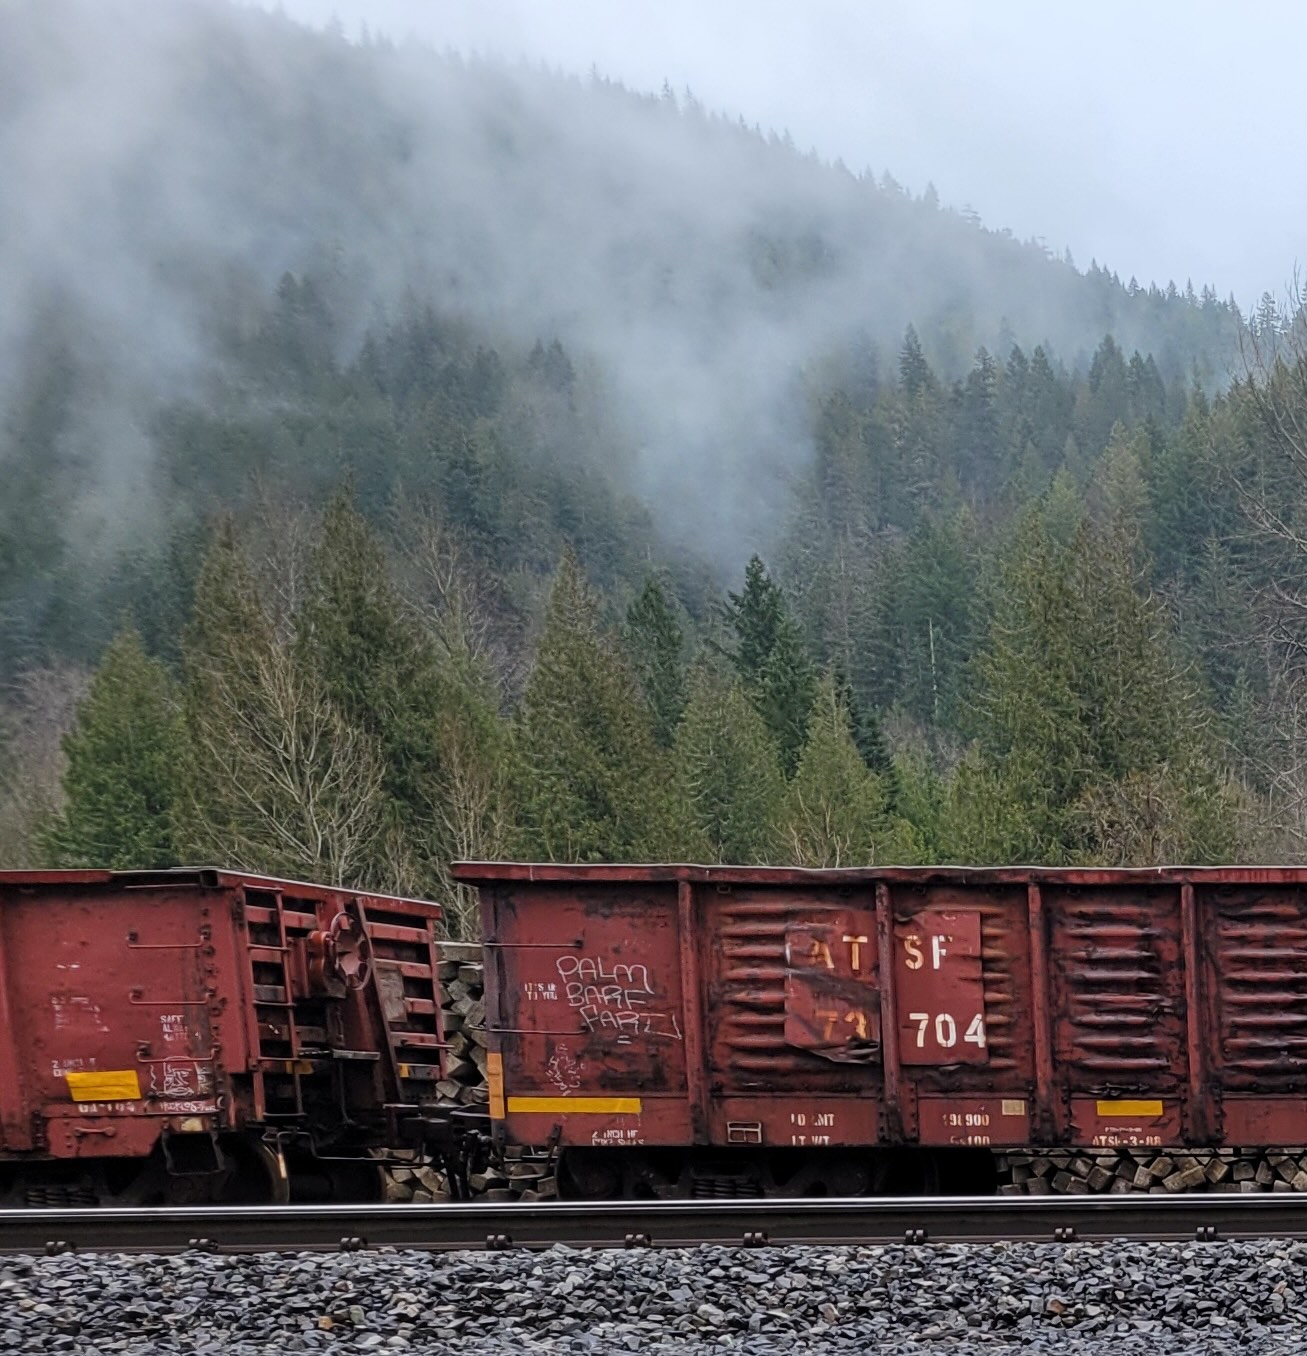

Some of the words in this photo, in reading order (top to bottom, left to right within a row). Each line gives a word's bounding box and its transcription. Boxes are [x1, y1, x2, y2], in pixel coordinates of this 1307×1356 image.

[556, 956, 655, 995] PALM
[566, 982, 648, 1010] BARF
[909, 1012, 986, 1048] 704
